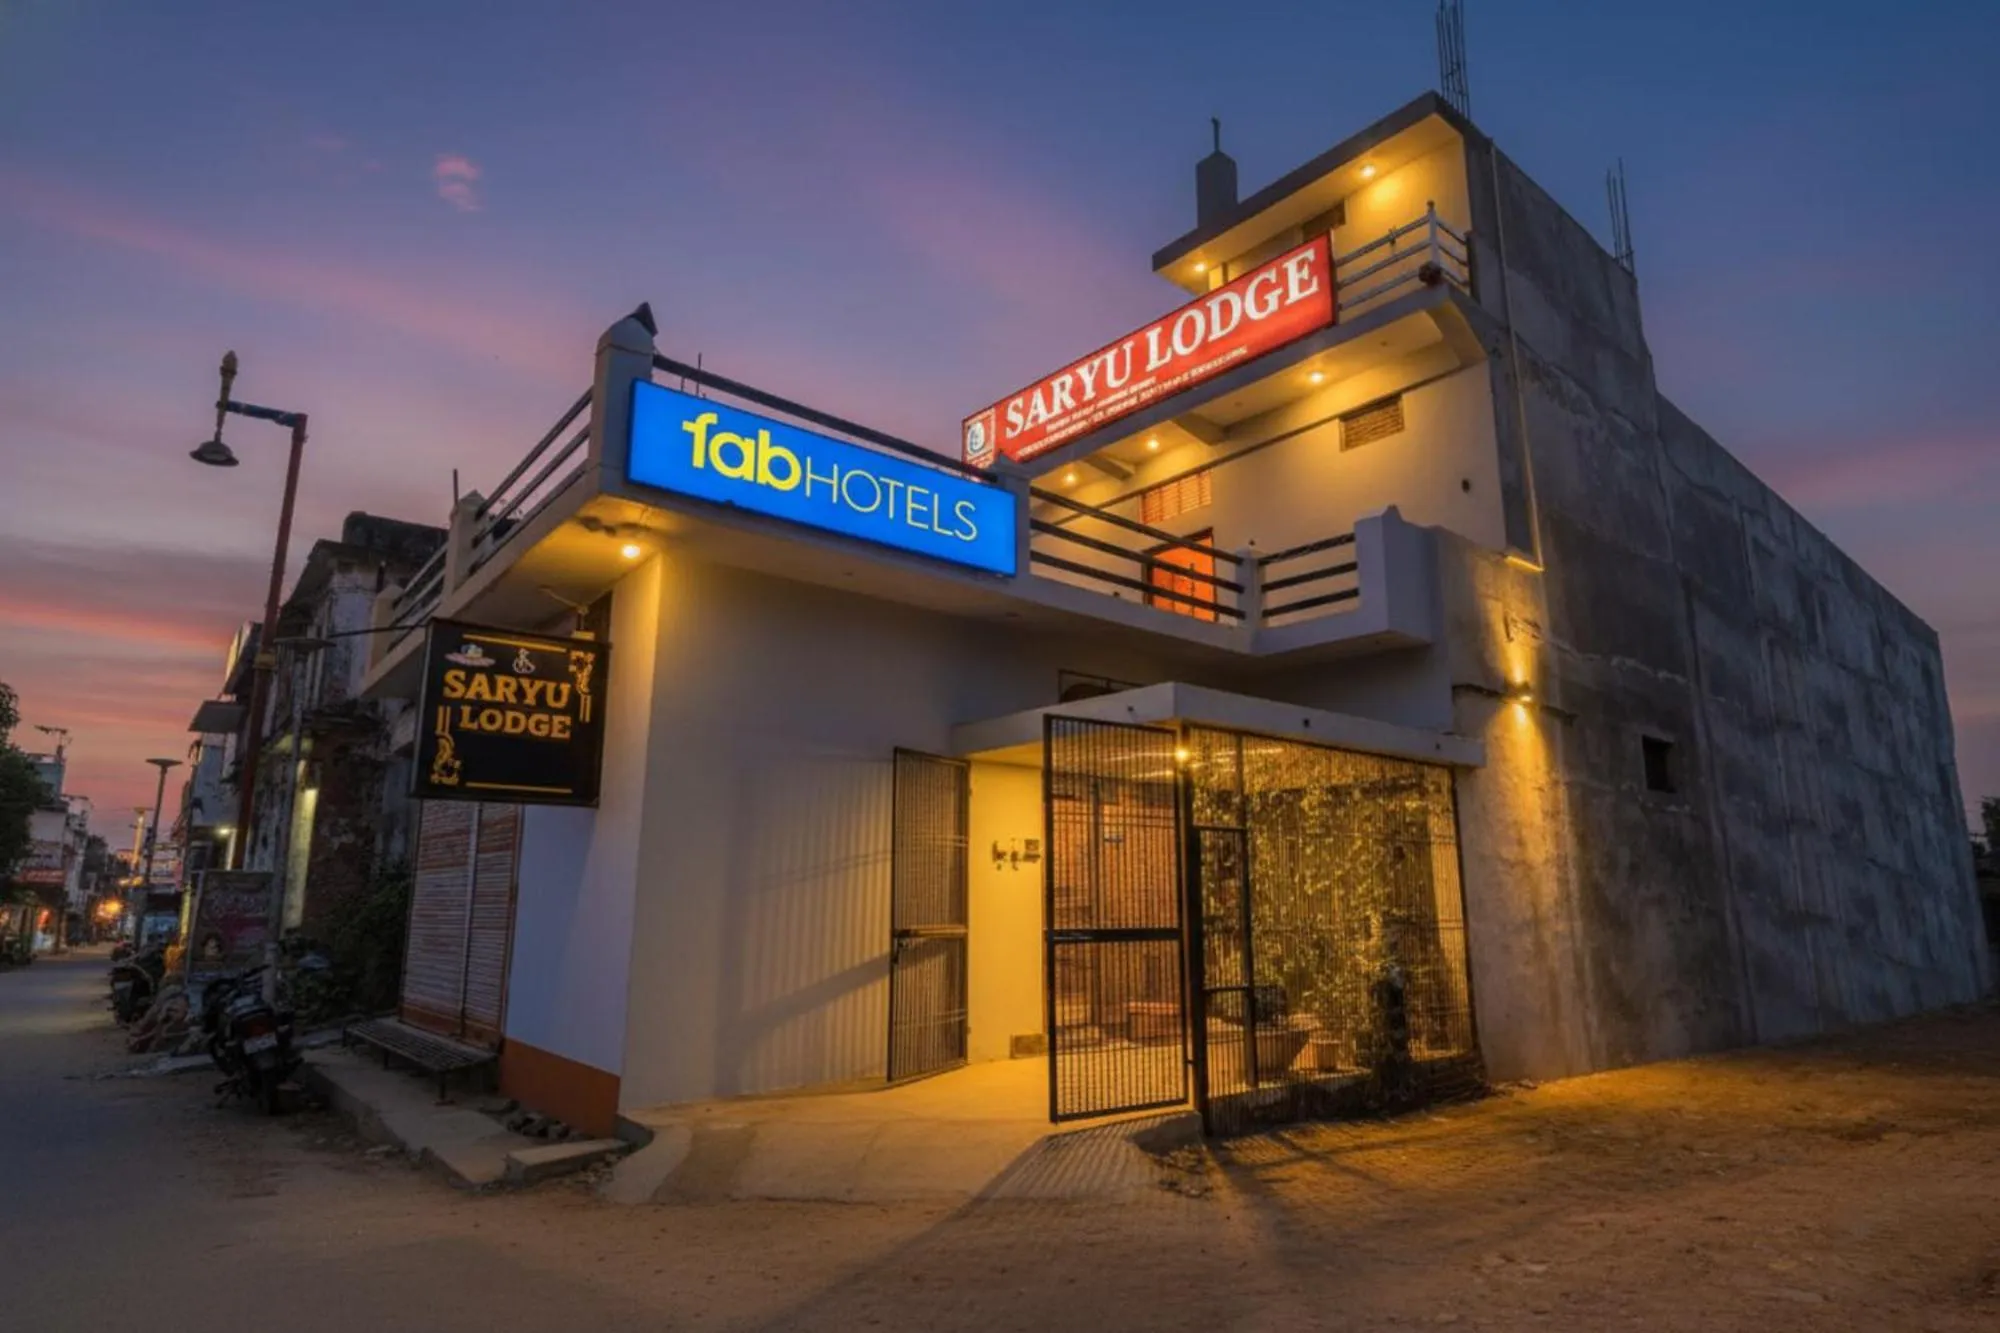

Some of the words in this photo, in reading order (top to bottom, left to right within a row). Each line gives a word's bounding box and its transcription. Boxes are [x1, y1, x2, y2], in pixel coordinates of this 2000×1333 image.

[1006, 342, 1133, 438] SARYU
[1146, 248, 1318, 371] LODGE
[443, 669, 570, 708] SARYU
[460, 705, 572, 739] LODGE
